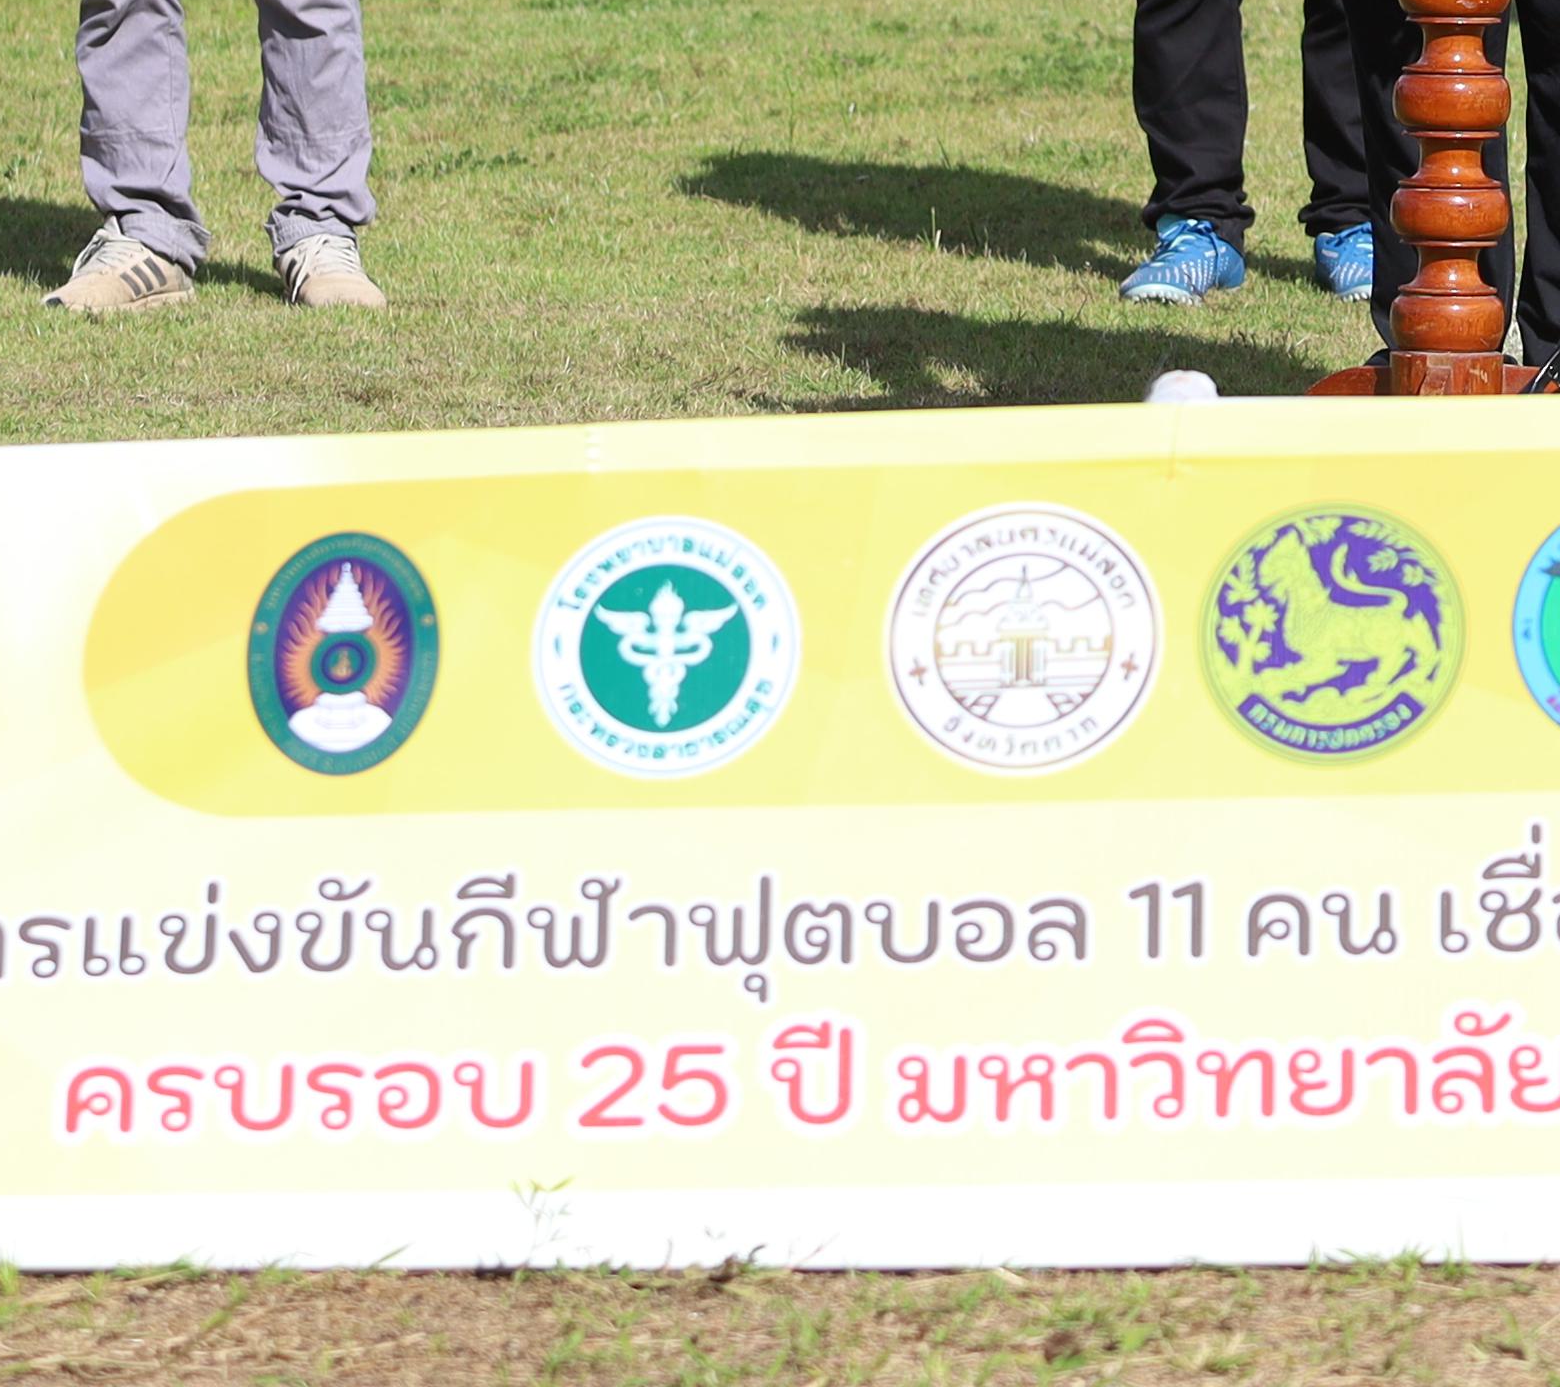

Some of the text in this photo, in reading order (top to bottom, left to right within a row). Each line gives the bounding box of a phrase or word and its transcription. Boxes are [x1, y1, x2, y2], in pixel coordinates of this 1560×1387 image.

[1128, 881, 1204, 959] 11
[1246, 889, 1399, 957] คน
[64, 1058, 536, 1133] ครบรอบ
[577, 1043, 729, 1128] 25
[770, 1020, 854, 1124] ปี
